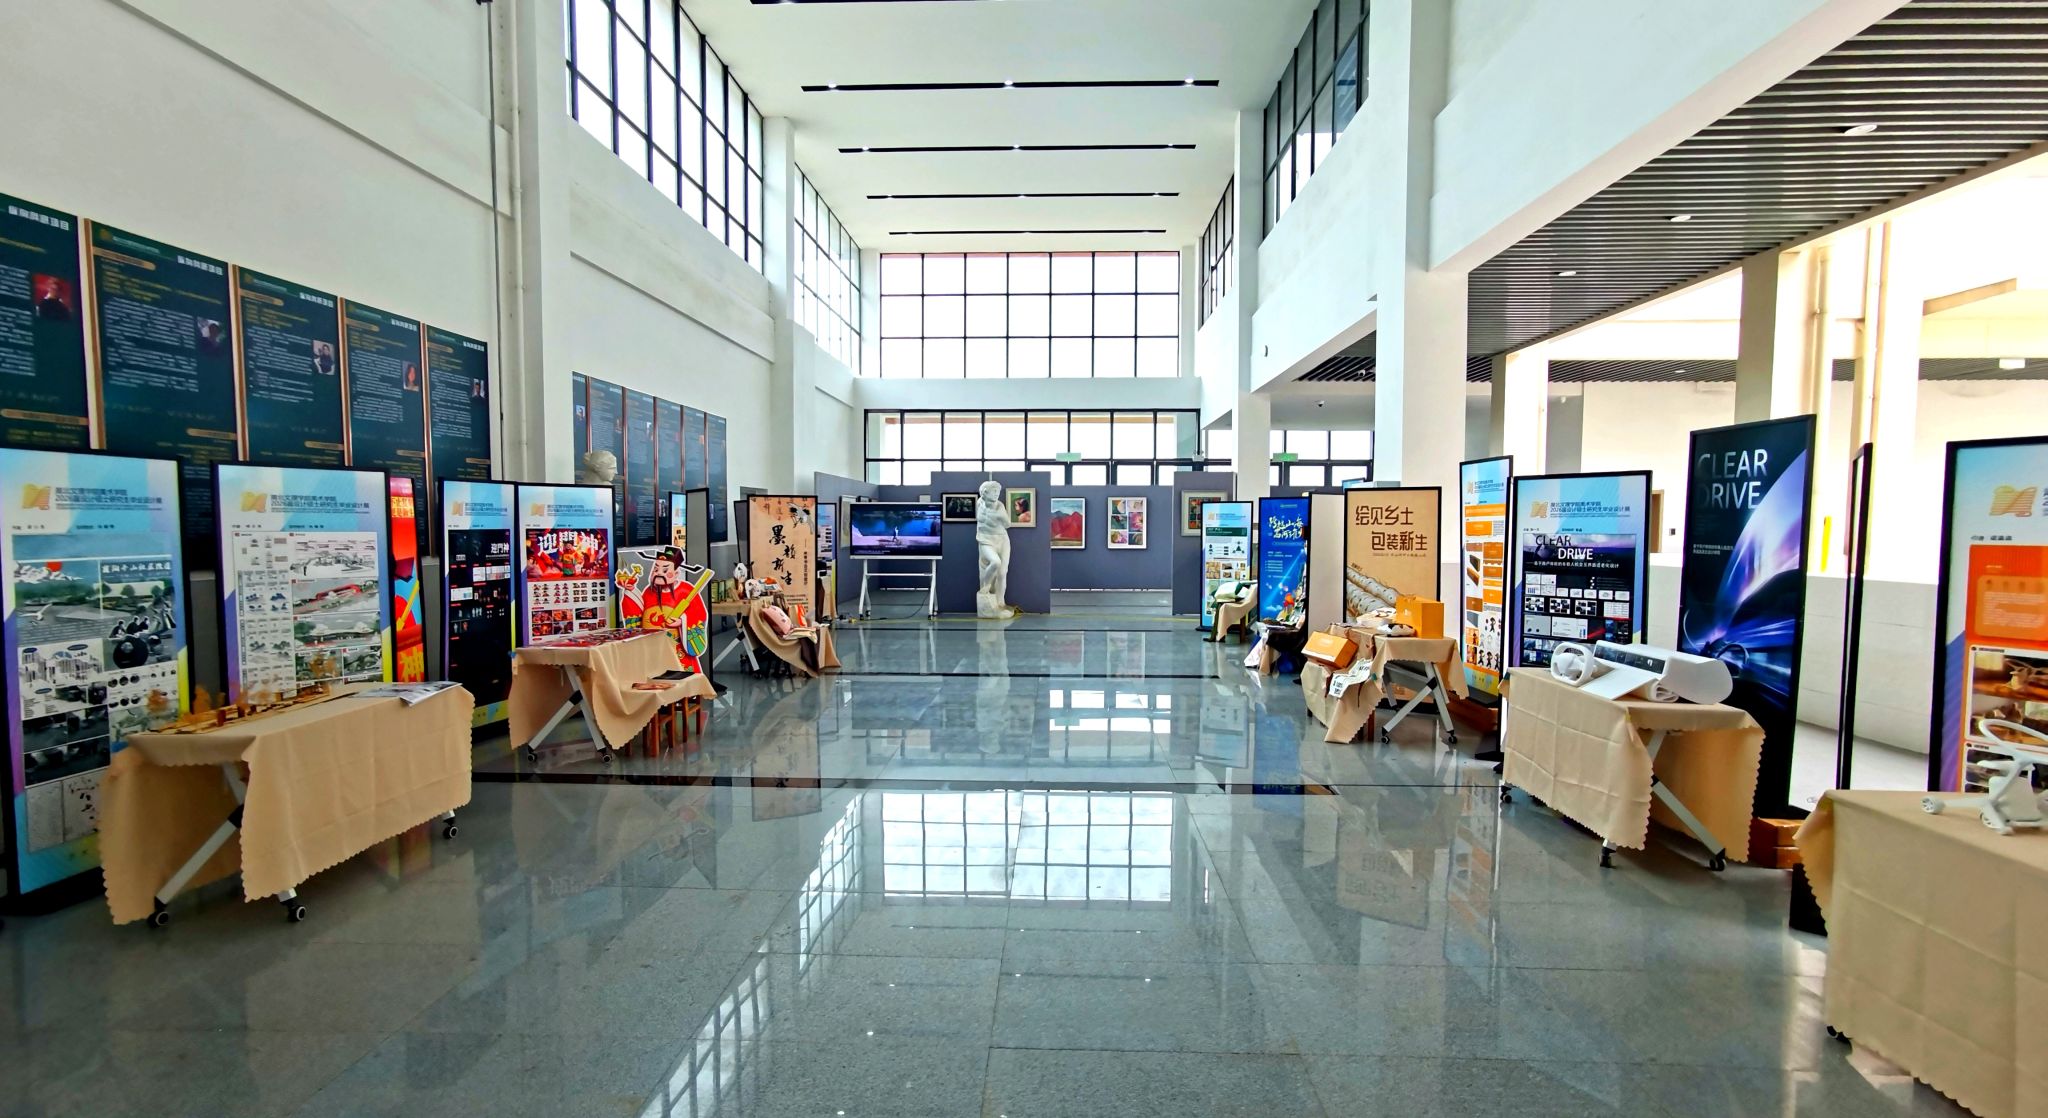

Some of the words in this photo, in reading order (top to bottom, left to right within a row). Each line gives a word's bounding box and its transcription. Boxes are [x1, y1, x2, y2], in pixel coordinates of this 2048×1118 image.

[1696, 448, 1768, 478] CLEAR
[1696, 481, 1762, 510] DRIVE
[1355, 505, 1414, 526] 绘见乡土
[1371, 531, 1428, 551] 包装新生
[1535, 535, 1572, 547] CLEAR
[1557, 548, 1594, 560] DRIVE
